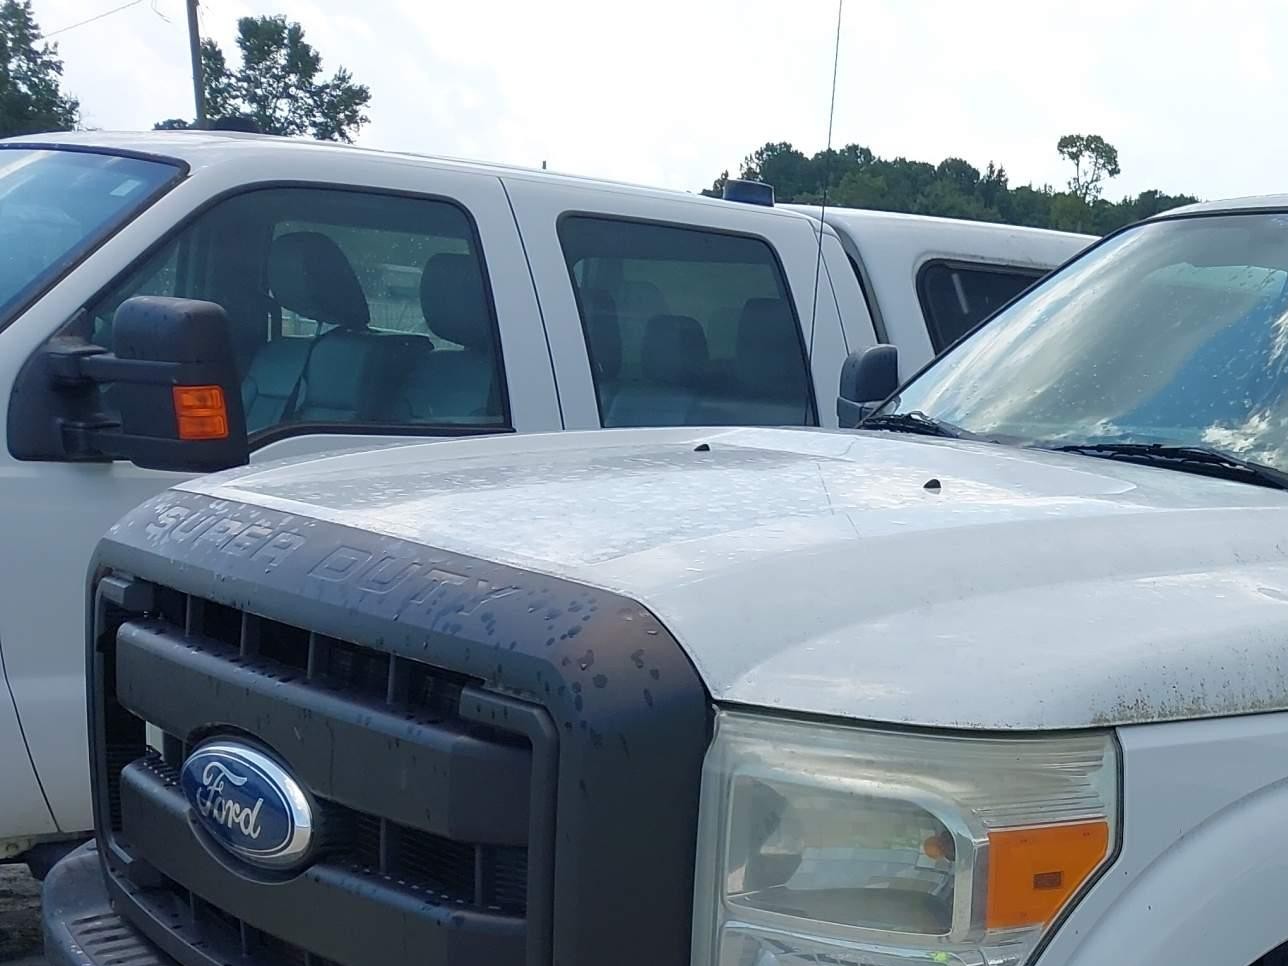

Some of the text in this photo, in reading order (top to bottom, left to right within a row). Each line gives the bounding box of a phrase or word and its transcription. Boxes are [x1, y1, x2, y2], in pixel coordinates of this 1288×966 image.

[144, 503, 523, 617] SUPER DUTY
[196, 761, 264, 839] Ford
